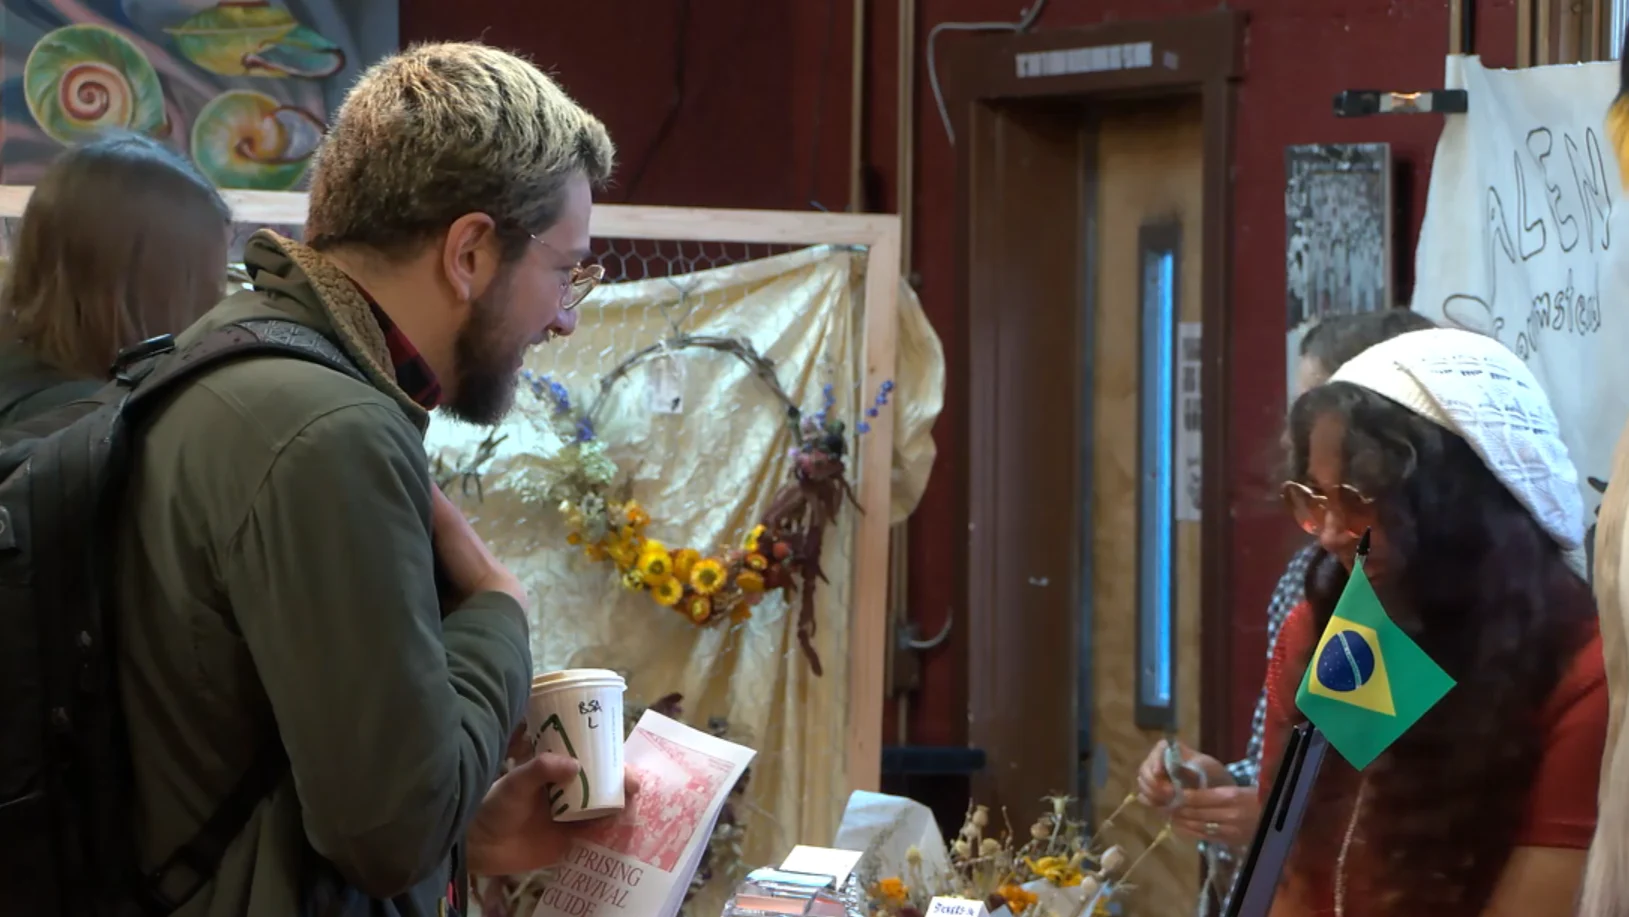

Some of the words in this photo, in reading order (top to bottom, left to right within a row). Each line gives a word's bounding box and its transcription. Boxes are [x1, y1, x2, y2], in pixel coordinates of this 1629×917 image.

[587, 716, 599, 729] L
[564, 847, 644, 887] UPRISING
[542, 887, 597, 917] GUIDE
[553, 866, 633, 908] SURVIVAL
